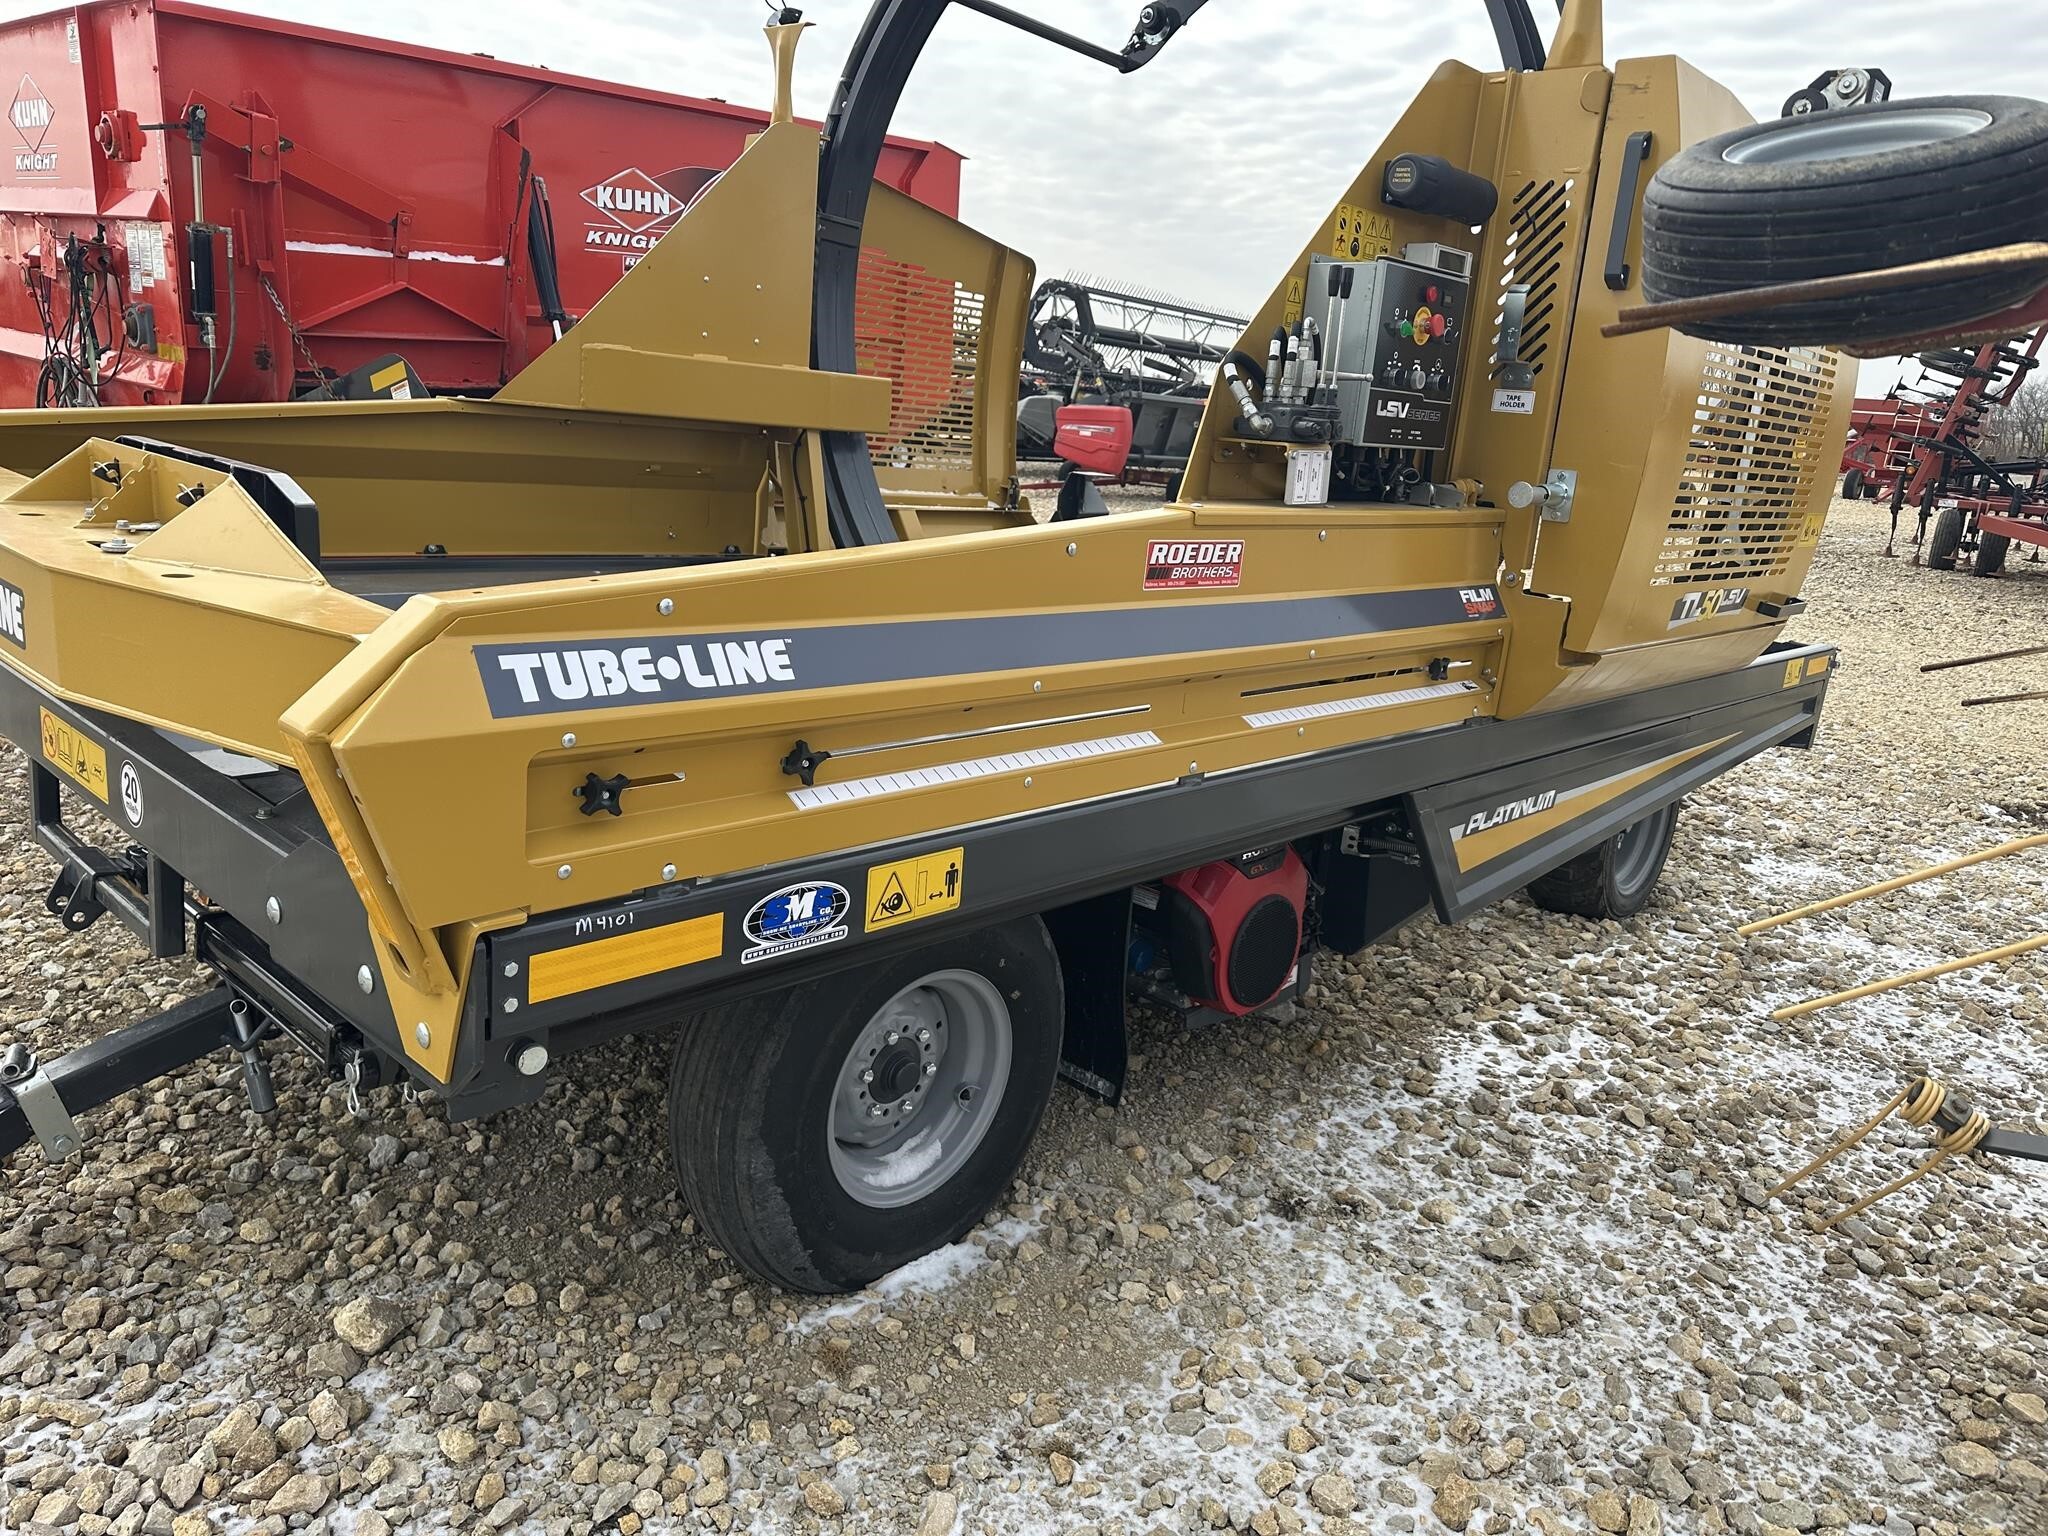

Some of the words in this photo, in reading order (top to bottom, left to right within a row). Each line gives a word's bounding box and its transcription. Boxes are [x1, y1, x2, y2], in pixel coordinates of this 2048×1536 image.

[13, 98, 49, 128] KUHN
[15, 153, 58, 171] KNIGHT
[596, 185, 670, 215] KUHN
[1500, 401, 1526, 409] HOLDER
[1506, 394, 1522, 402] TAPE
[1376, 399, 1410, 418] LSV
[1407, 408, 1441, 421] SERIES
[1149, 543, 1242, 566] ROEDER
[1171, 566, 1234, 579] BROTHERS
[1459, 588, 1495, 604] FILM
[124, 771, 138, 804] 20
[1465, 789, 1557, 836] PLATINUM
